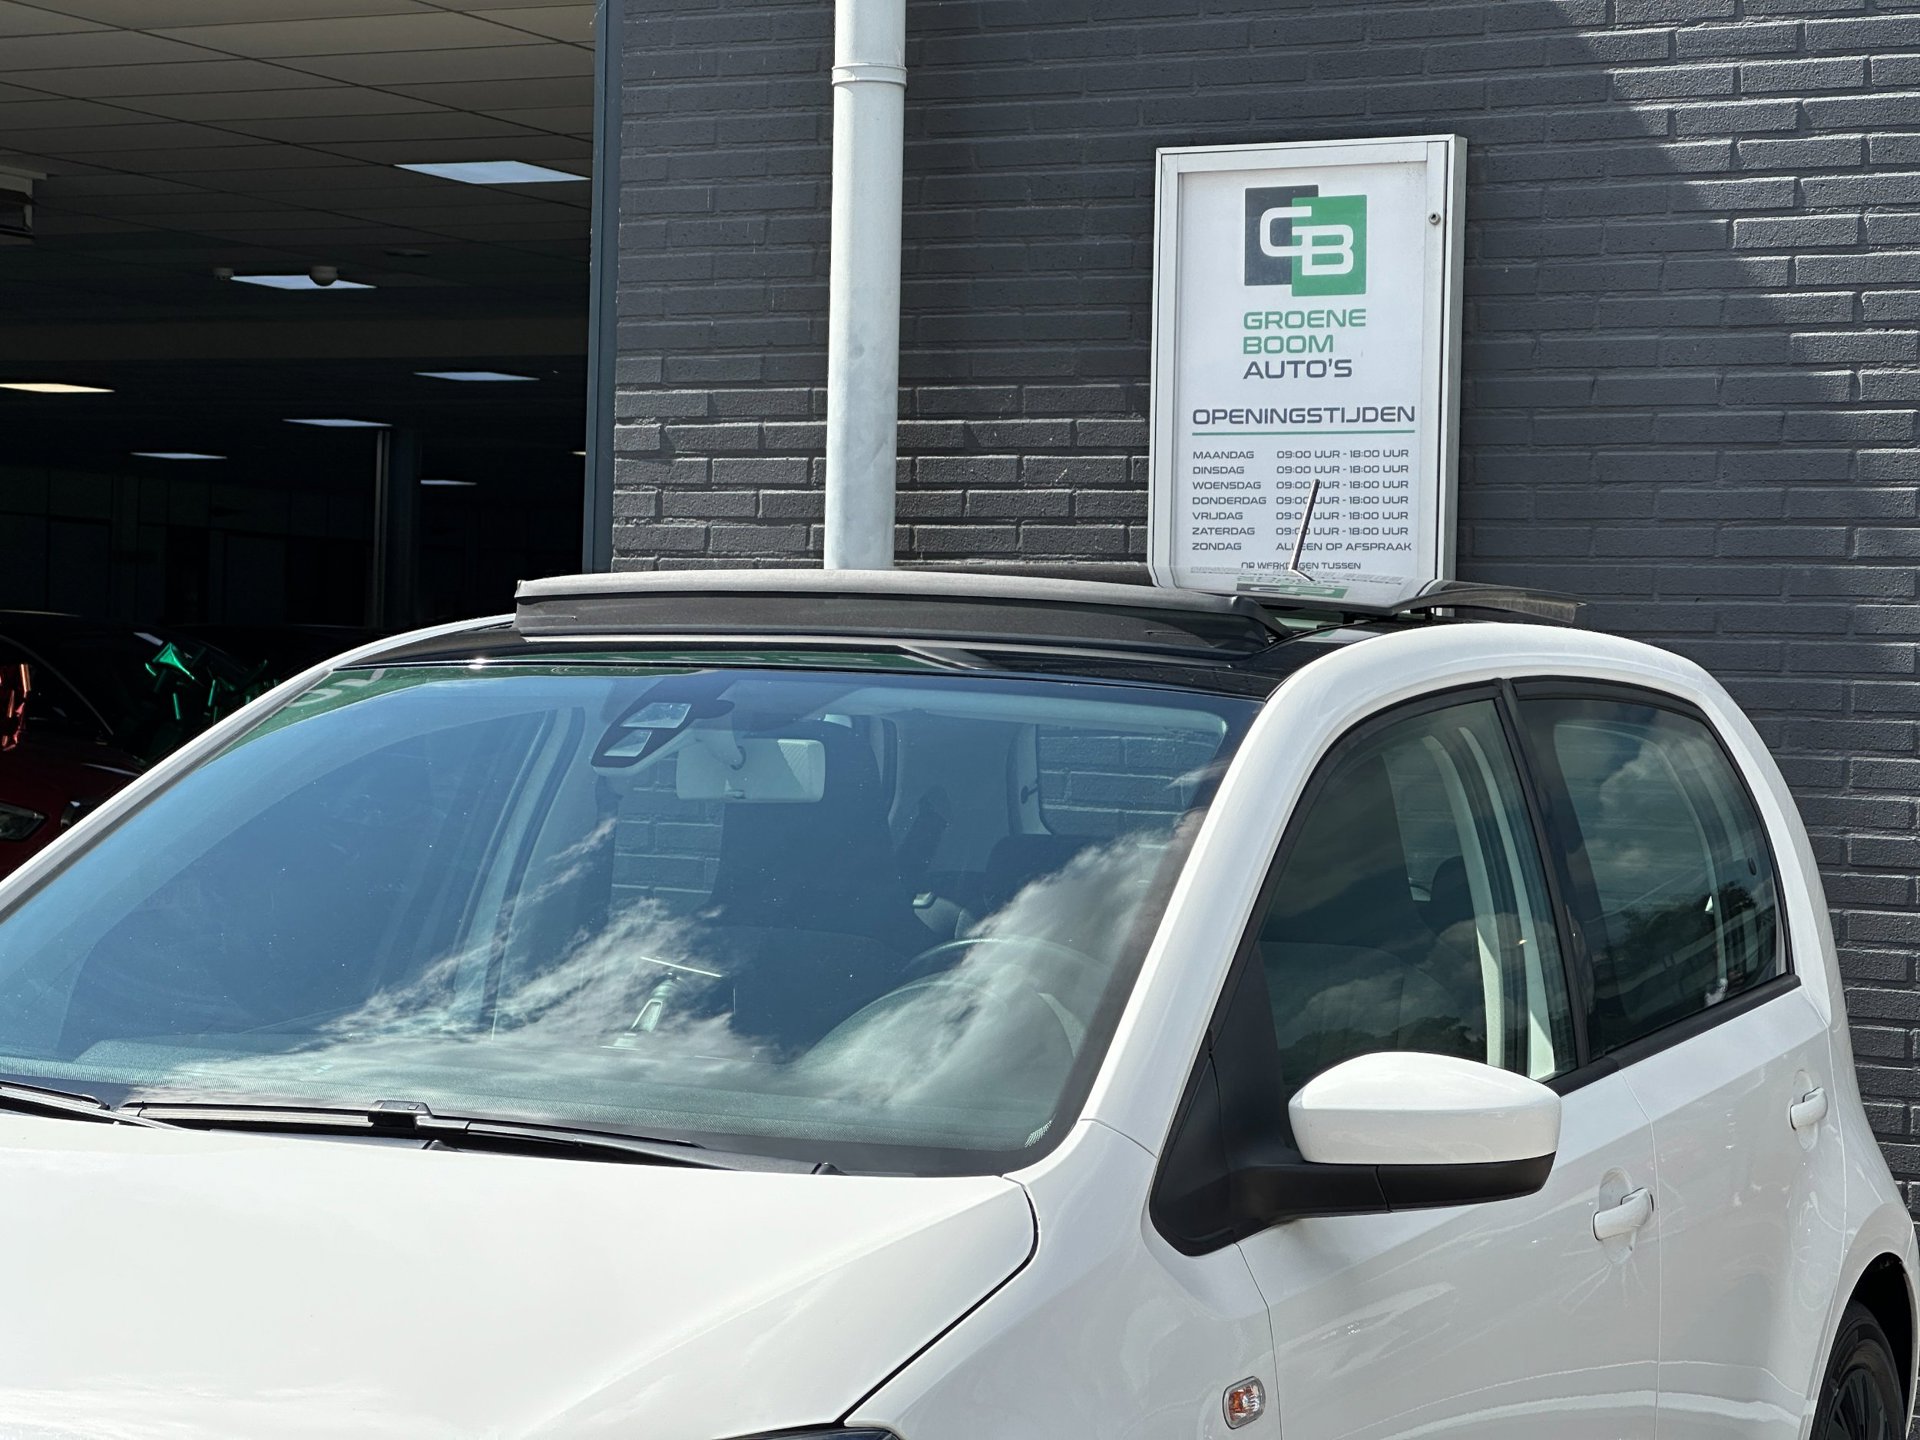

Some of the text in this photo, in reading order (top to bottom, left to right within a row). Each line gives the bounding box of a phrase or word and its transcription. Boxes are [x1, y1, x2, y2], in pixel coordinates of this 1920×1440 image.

[1244, 308, 1366, 330] GROENE
[1243, 334, 1334, 354] BOOM
[1243, 359, 1352, 379] AUTO'S
[1192, 406, 1415, 425] OPENINGSTIJDEN
[1192, 450, 1254, 460] MAANDAG
[1276, 450, 1311, 459] 09:00
[1314, 450, 1340, 458] UUR
[1349, 450, 1380, 458] 18:00
[1383, 450, 1408, 458] UUR
[1192, 466, 1244, 475] DINSDAG
[1276, 465, 1311, 474] 09:00
[1314, 465, 1340, 474] UUR
[1349, 465, 1380, 473] 18:00
[1383, 465, 1408, 473] UUR
[1192, 481, 1261, 490] WOENSDAG
[1276, 481, 1310, 490] 09:00
[1349, 480, 1380, 489] 18:00
[1383, 480, 1408, 489] UUR
[1192, 496, 1266, 505] DONDERDAG
[1314, 496, 1340, 505] UUR
[1349, 496, 1380, 504] 18:00
[1383, 496, 1408, 504] UUR
[1192, 512, 1243, 521] VRIJDAG
[1276, 512, 1305, 520] 09:0
[1314, 512, 1340, 520] UUR
[1349, 511, 1380, 520] 18:00
[1383, 511, 1408, 519] UUR
[1192, 527, 1255, 535] ZATERDAG
[1314, 527, 1340, 535] UUR
[1349, 527, 1380, 535] 18:00
[1383, 527, 1408, 535] UUR
[1192, 542, 1242, 550] ZONDAG
[1326, 542, 1342, 550] OP
[1346, 542, 1411, 551] AFSPRAAK
